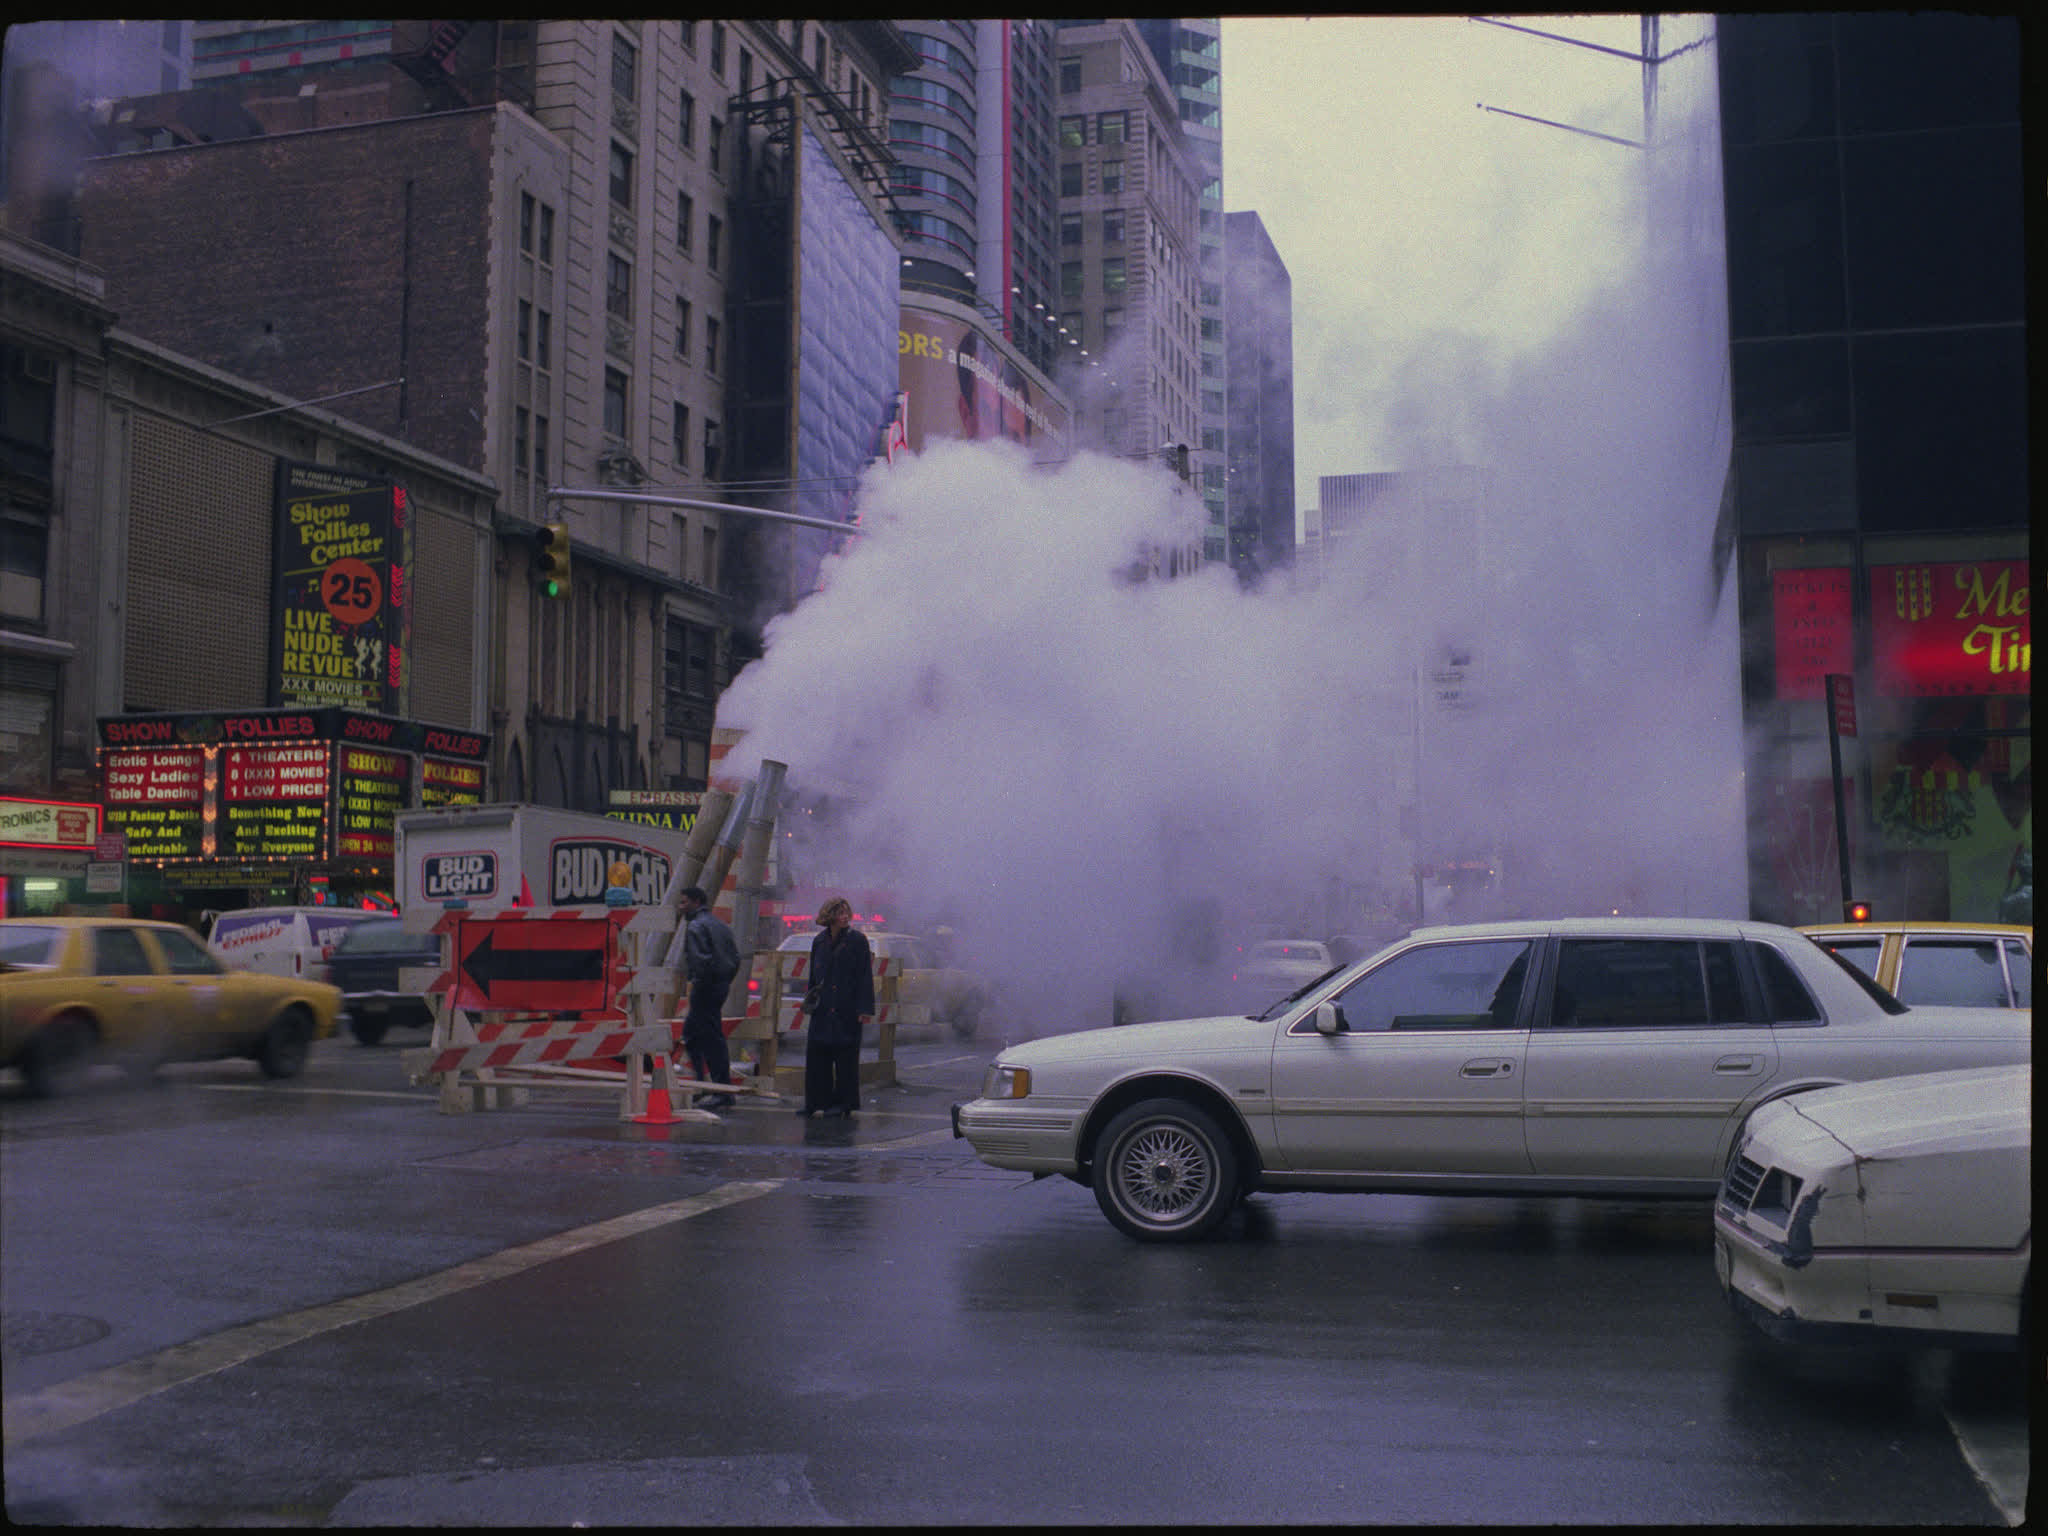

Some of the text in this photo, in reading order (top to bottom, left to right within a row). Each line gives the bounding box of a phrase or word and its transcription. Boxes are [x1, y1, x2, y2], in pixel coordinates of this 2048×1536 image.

[290, 502, 350, 526] Show
[300, 520, 371, 544] Follies
[310, 537, 384, 565] Center
[329, 574, 372, 609] 25
[284, 608, 333, 633] LIVE
[284, 630, 345, 656] NUDE
[282, 651, 354, 678] REVUE
[281, 676, 363, 697] XXX MOVIES
[106, 716, 315, 742] SHOW FOLLIES
[343, 717, 481, 756] SHOW FOLLIES
[109, 754, 147, 768] Erotic
[231, 749, 324, 763] 4 THEATERS
[347, 752, 397, 774] SHOW
[109, 770, 199, 785] Sexy Ladies
[230, 766, 324, 781] 8 (XXX) MOVIES
[424, 762, 481, 785] FOLLIES
[109, 786, 199, 801] Table Dancing
[231, 784, 324, 797] 1 LOW PRICE
[630, 791, 701, 805] EMBASSY
[0, 809, 51, 829] RONICS
[229, 806, 323, 821] Something New
[351, 814, 371, 829] LOW
[125, 826, 182, 838] Safe And
[235, 824, 317, 839] And Exciting
[235, 841, 315, 855] For Everyone
[438, 855, 485, 874] BUD
[555, 848, 605, 900] BUD
[429, 872, 492, 894] LIGHT
